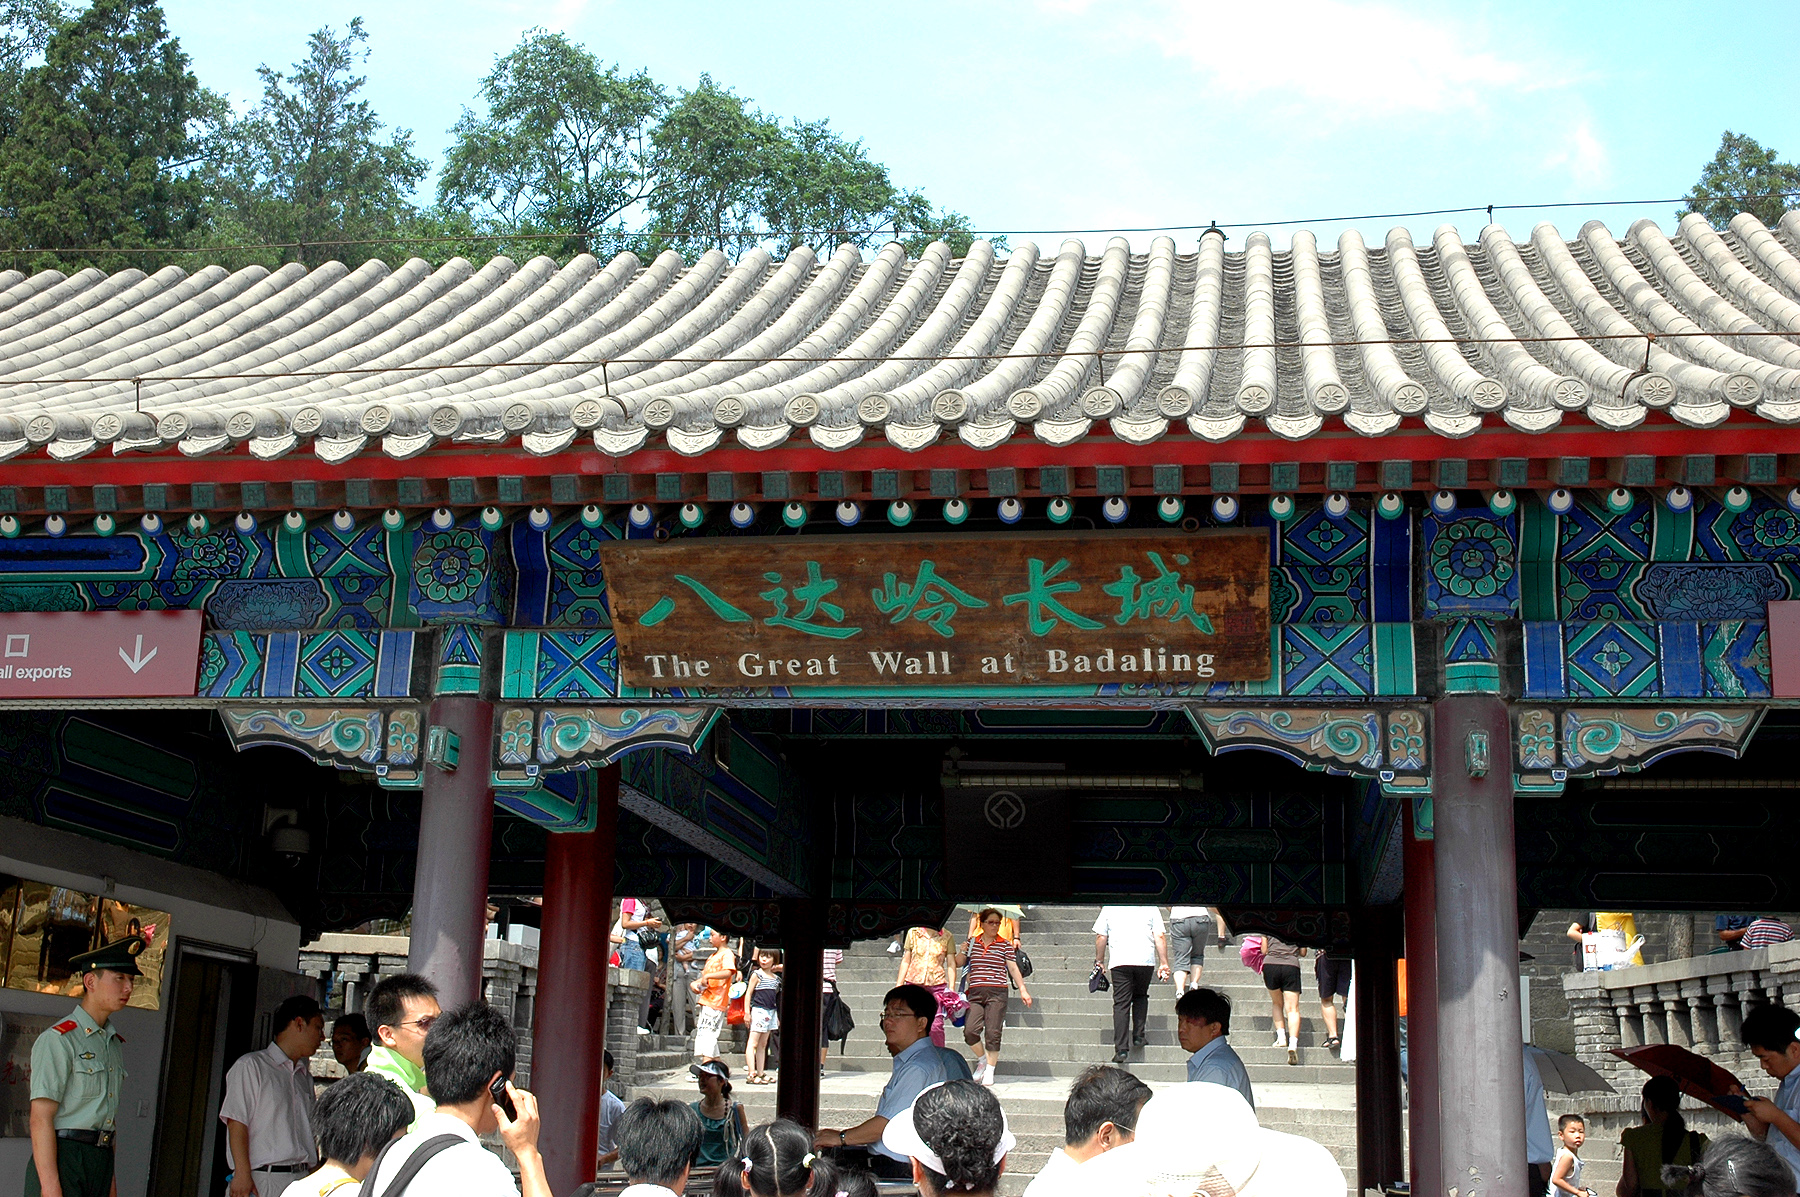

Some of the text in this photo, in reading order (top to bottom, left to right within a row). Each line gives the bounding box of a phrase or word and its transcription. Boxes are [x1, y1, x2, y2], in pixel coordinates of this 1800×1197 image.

[638, 550, 1215, 638] 八达岭长城
[15, 664, 72, 682] exports
[644, 647, 1216, 679] The Great Wall at Badaling
